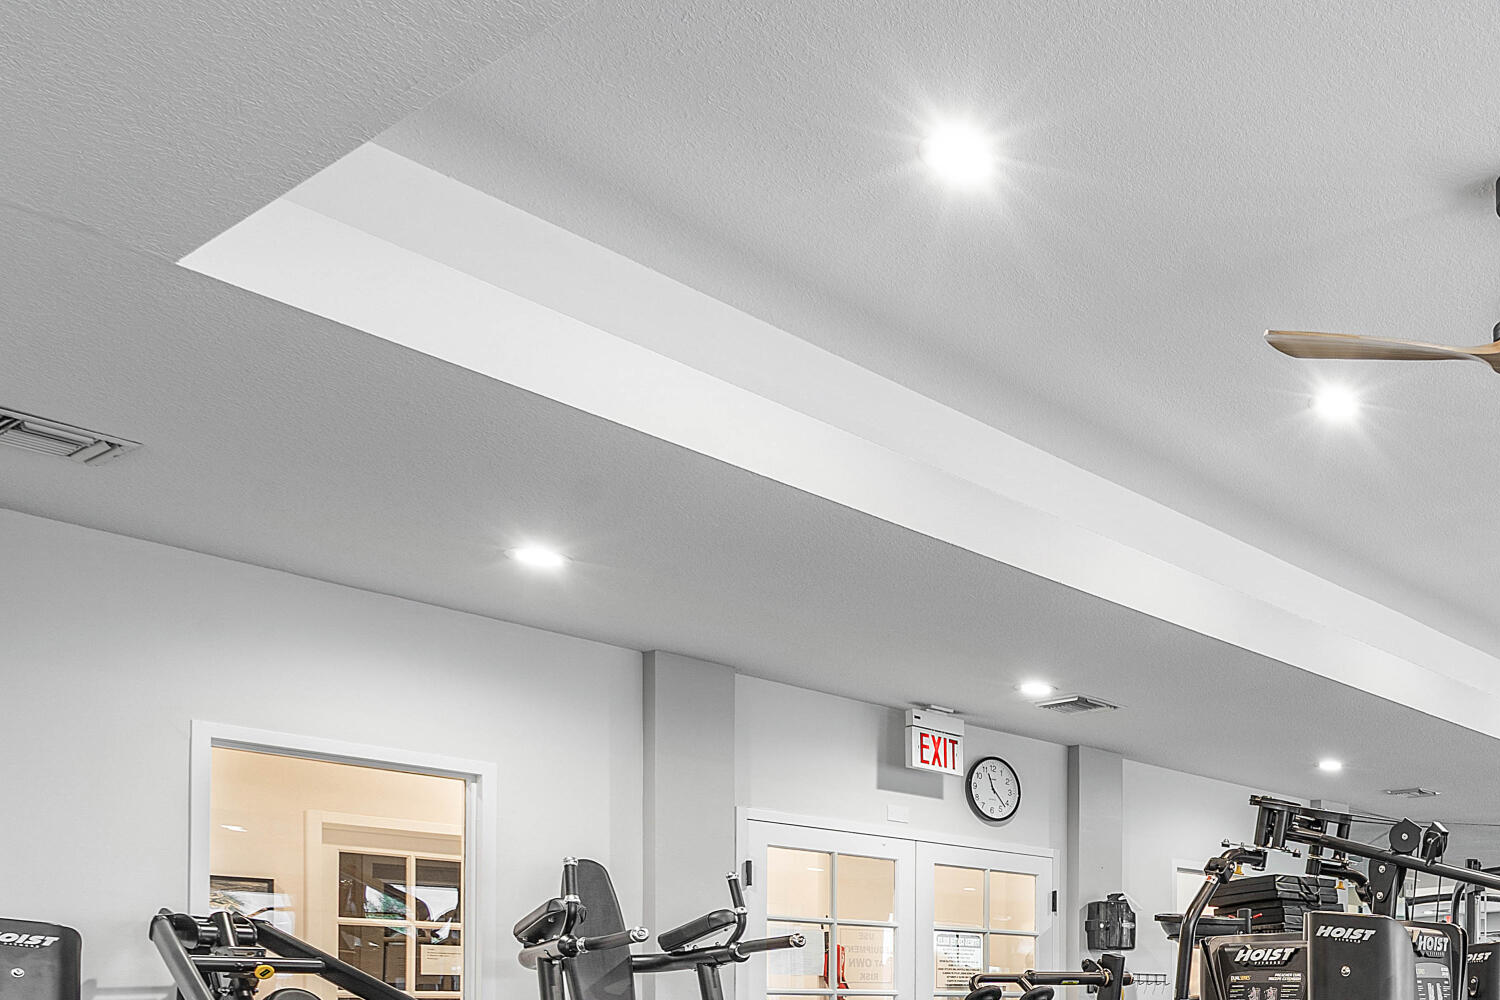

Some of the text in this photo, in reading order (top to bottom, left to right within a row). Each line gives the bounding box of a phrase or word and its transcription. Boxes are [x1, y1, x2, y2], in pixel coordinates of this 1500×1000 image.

[920, 732, 958, 770] EXIT
[976, 772, 983, 780] 10
[990, 765, 997, 773] 12
[0, 932, 60, 946] OIST
[1316, 925, 1376, 941] HOIST
[1417, 935, 1449, 952] HOIST
[1234, 948, 1295, 962] HOIST
[1467, 951, 1492, 961] OIST
